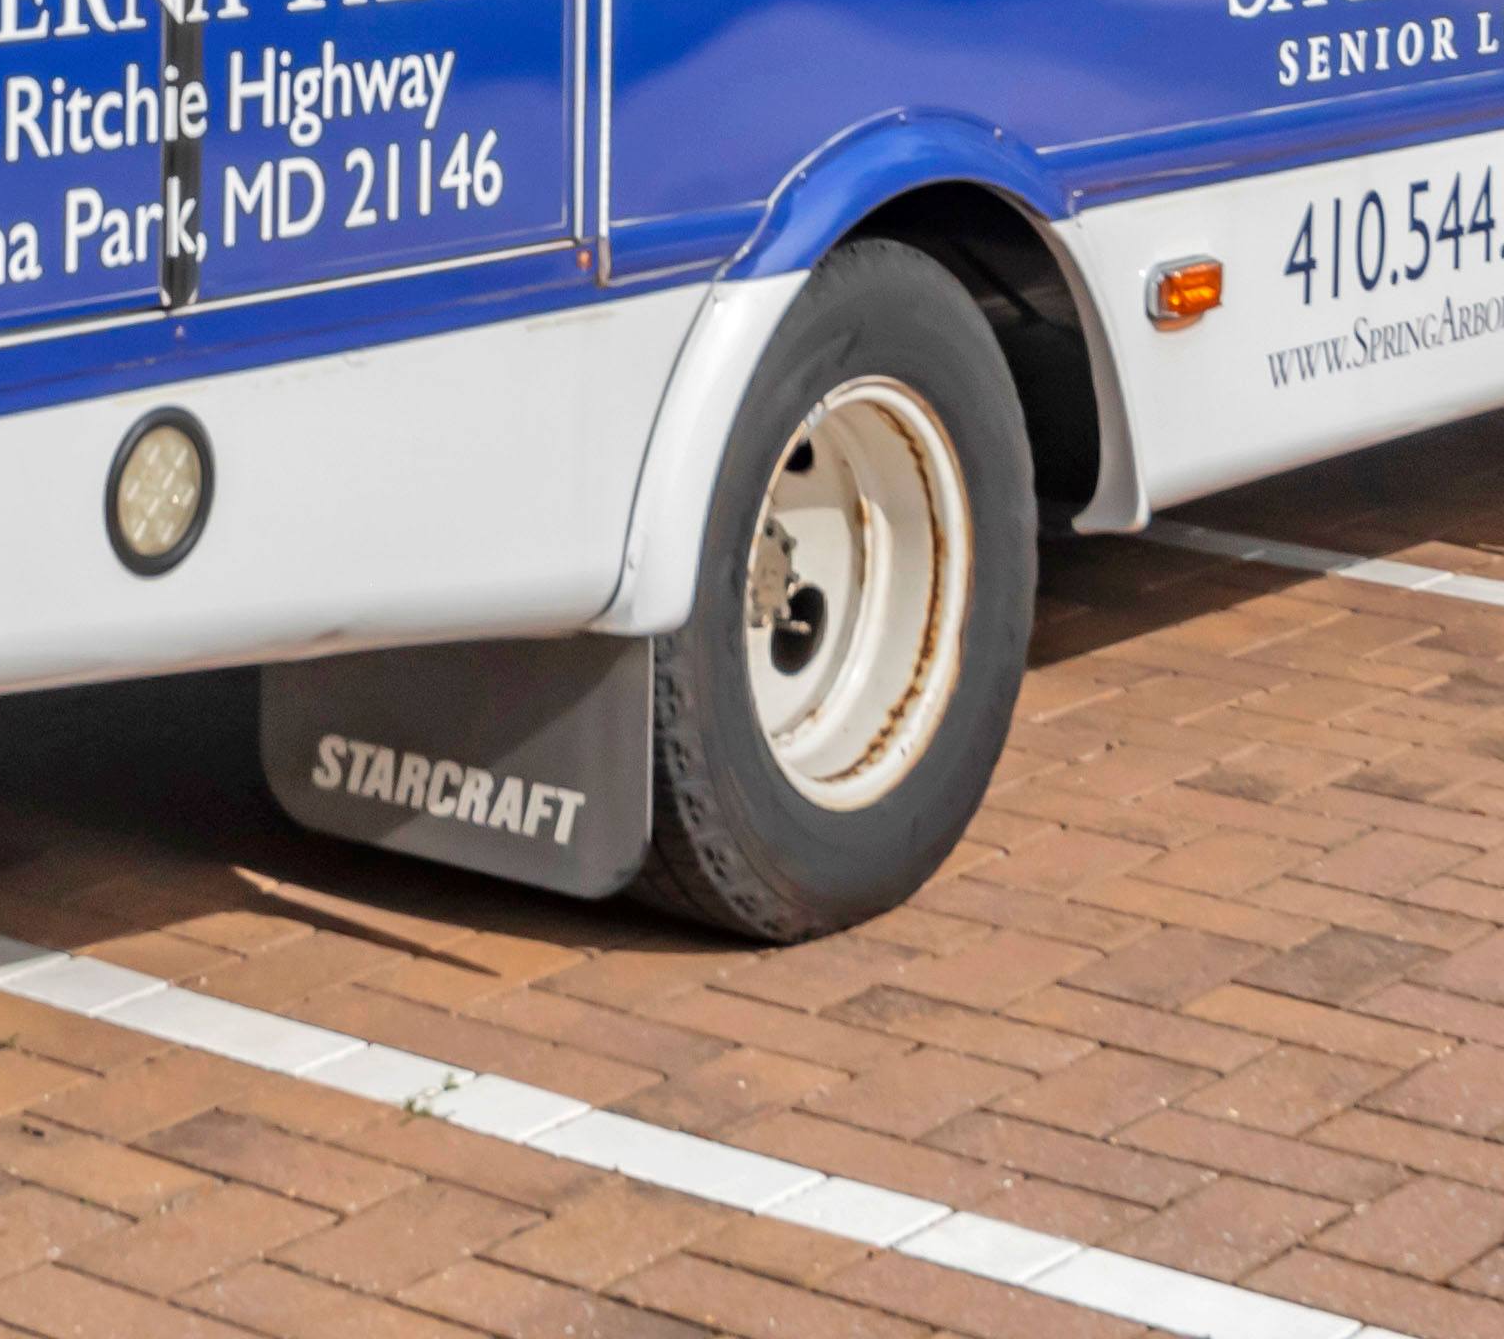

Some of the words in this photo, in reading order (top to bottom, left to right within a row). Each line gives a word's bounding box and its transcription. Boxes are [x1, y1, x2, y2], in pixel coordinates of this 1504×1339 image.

[4, 63, 208, 163] Ritchie
[229, 40, 455, 147] Highway
[1278, 19, 1458, 87] SENIOR
[65, 176, 208, 274] Park,
[224, 156, 325, 246] MD
[344, 129, 504, 230] 21146
[311, 734, 586, 846] STARCRAFT
